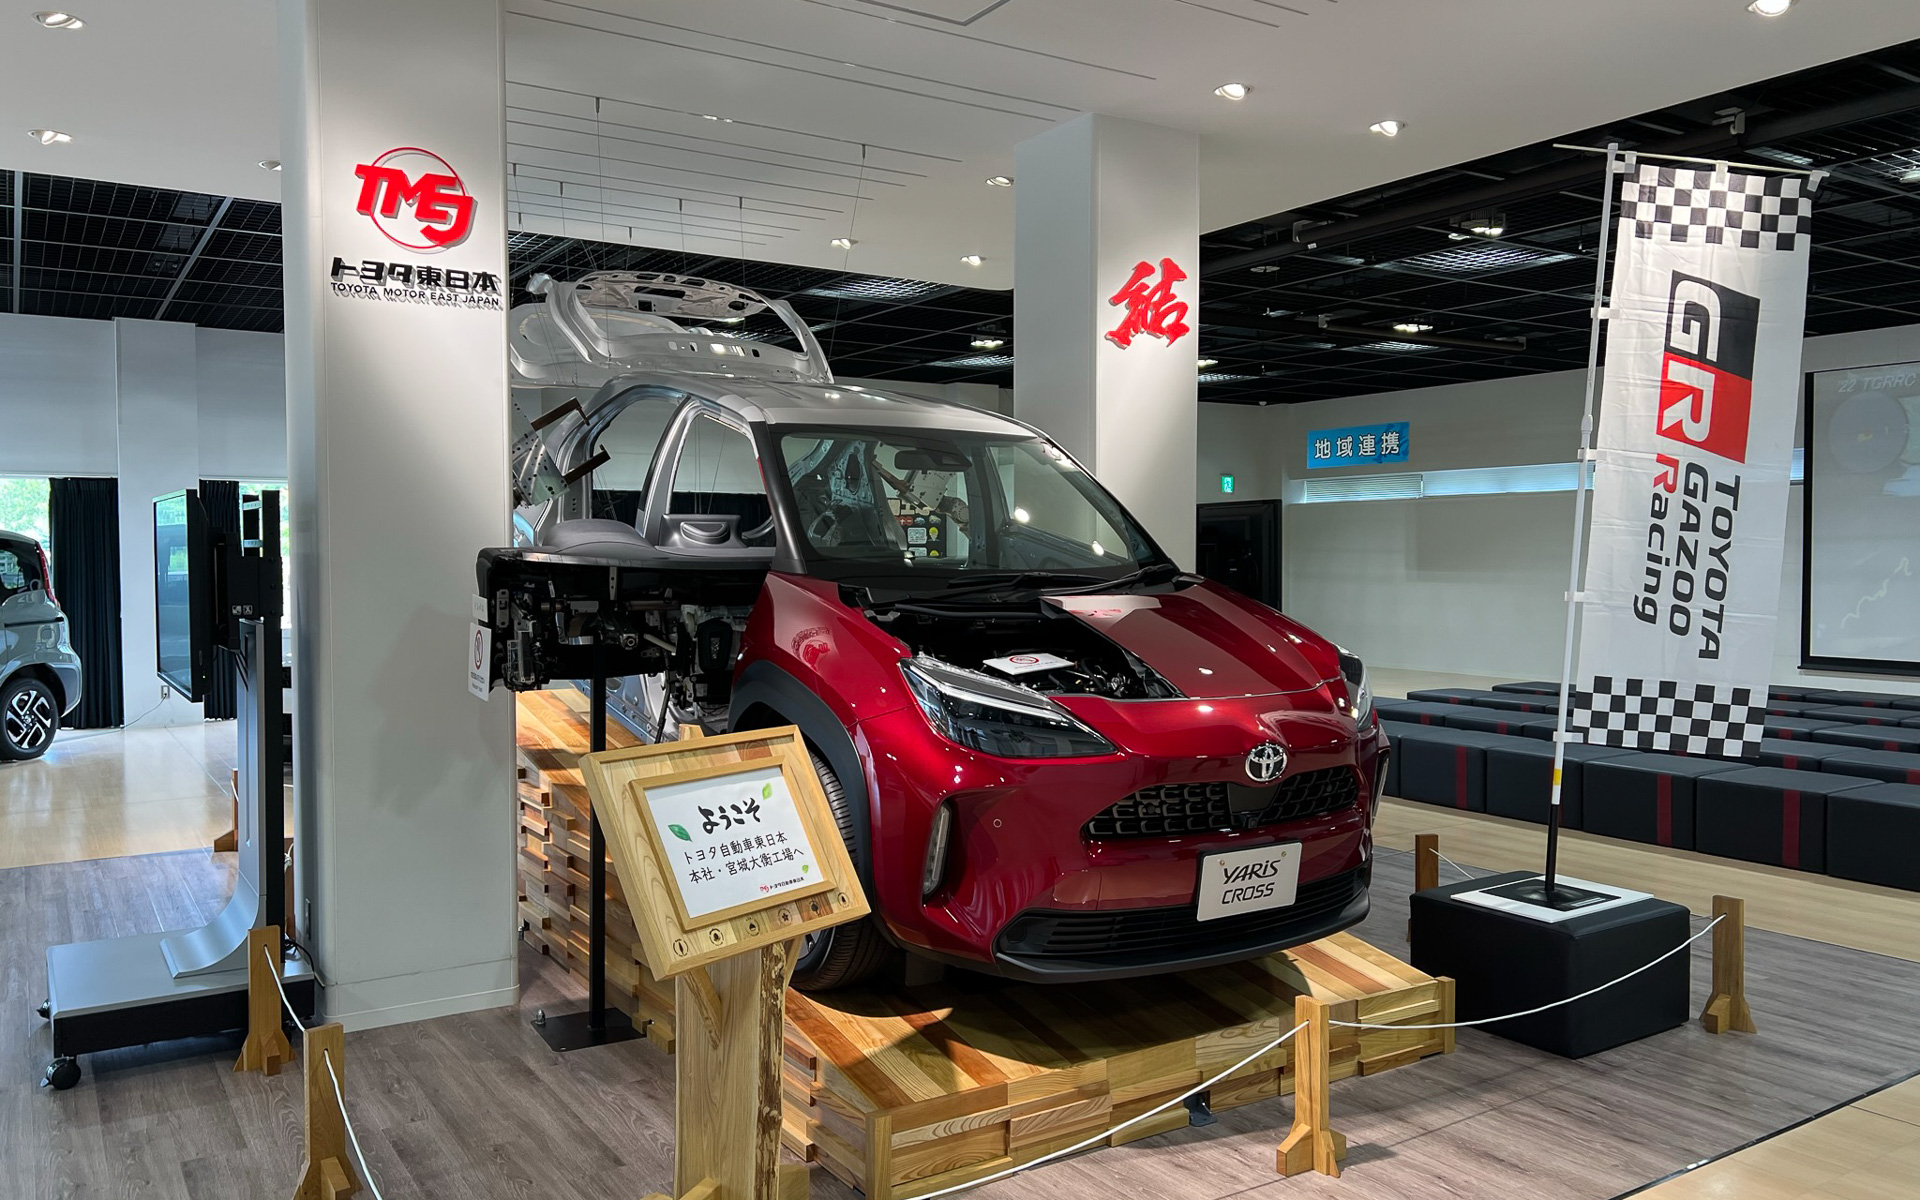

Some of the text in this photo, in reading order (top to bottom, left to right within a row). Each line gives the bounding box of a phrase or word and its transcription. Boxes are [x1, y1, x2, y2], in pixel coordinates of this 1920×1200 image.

[331, 257, 498, 291] トヨタ東日本
[331, 283, 499, 306] TOYOTA MOTOR EAST JAPAN
[1662, 279, 1721, 443] GR
[1315, 432, 1400, 459] 地域連携
[1633, 453, 1679, 625] Racing
[1669, 461, 1710, 637] GAZOO
[1698, 475, 1741, 660] TOYOTA
[698, 798, 760, 834] ようこそ
[684, 831, 788, 865] トヨタ自動車東日本
[689, 848, 804, 884] 本社・宮城大衡工場へ
[1222, 882, 1275, 904] CROSS
